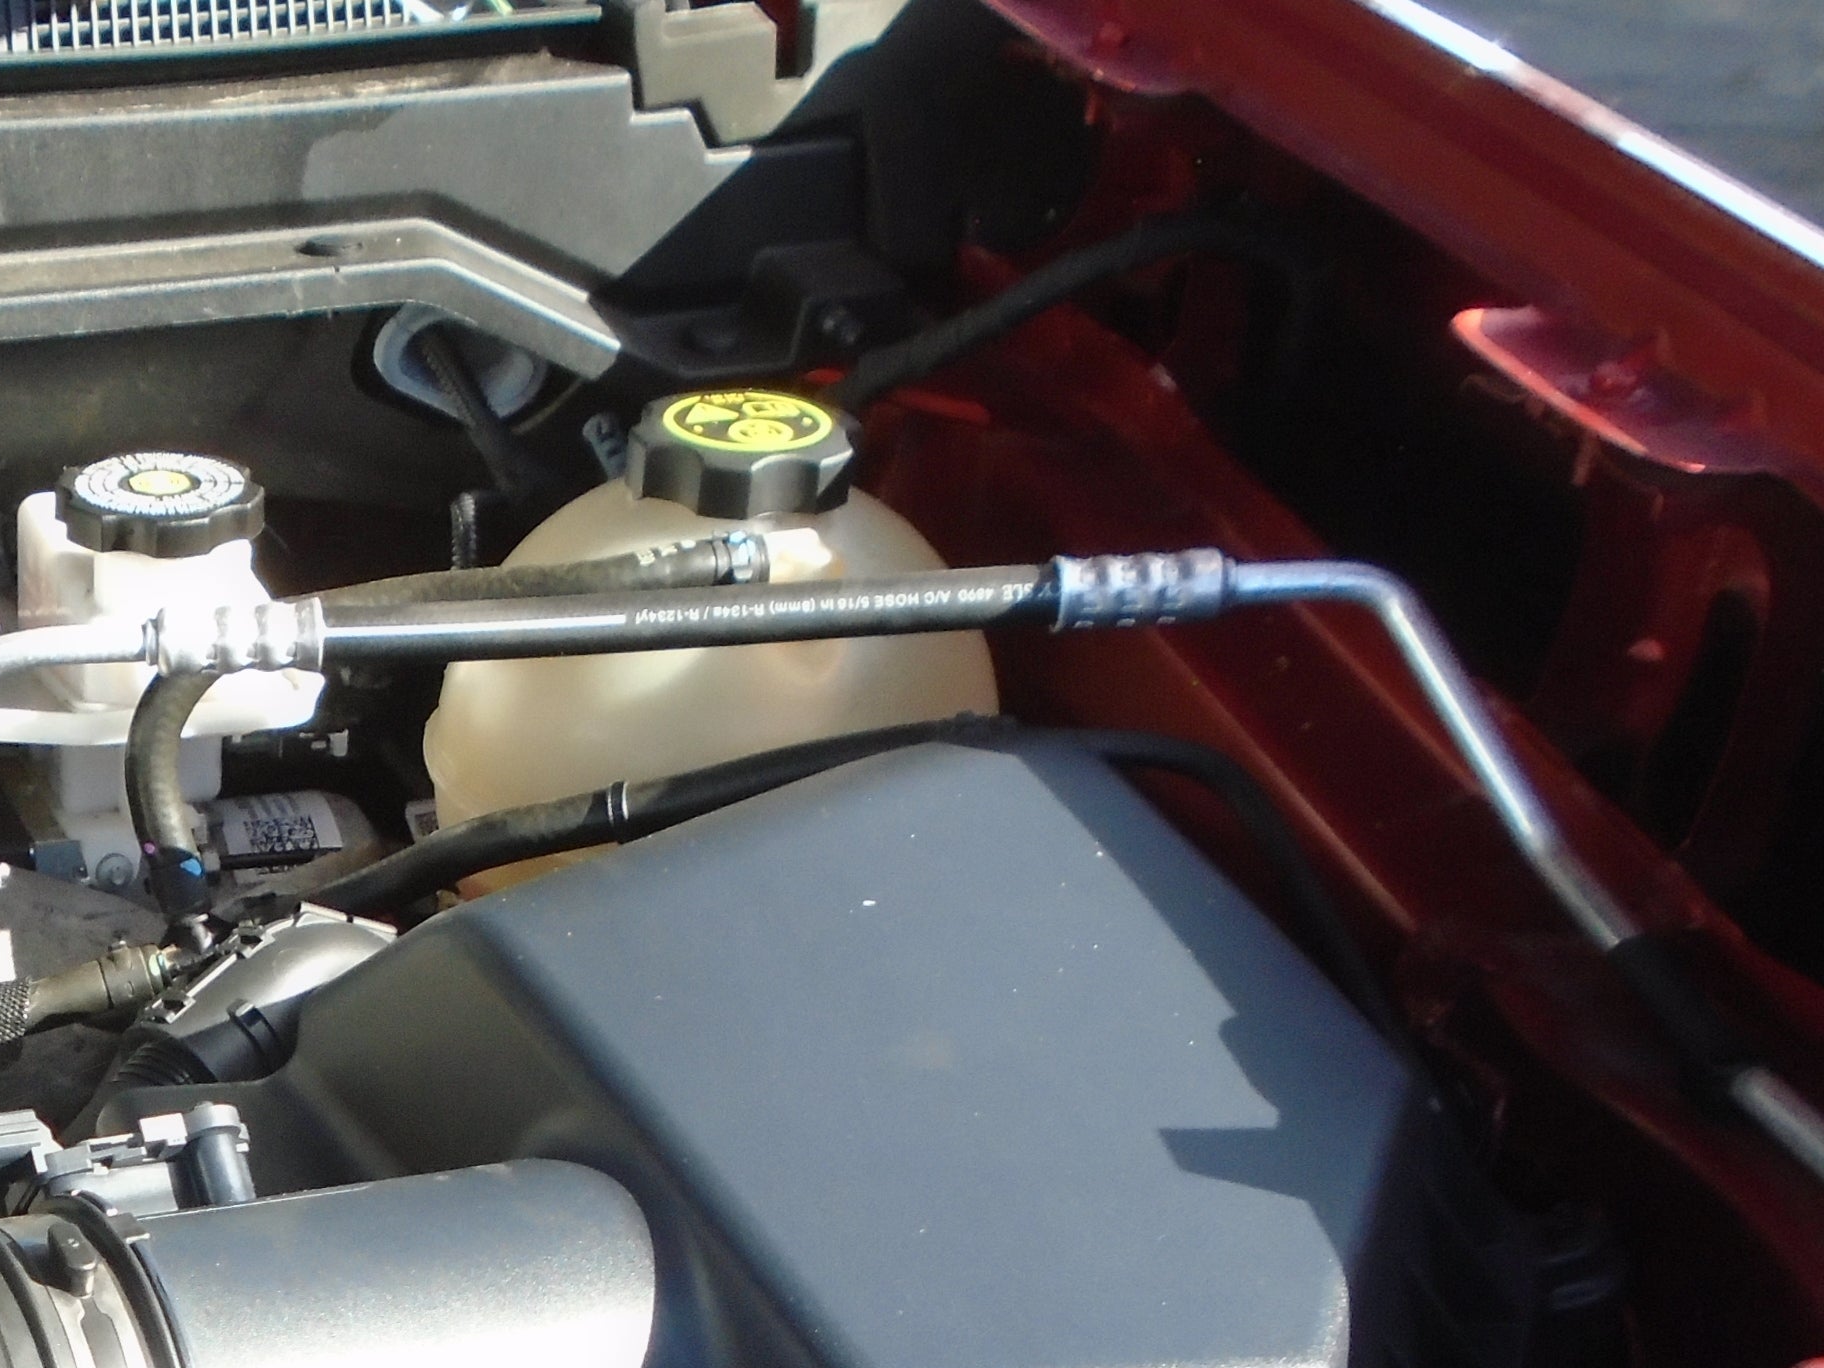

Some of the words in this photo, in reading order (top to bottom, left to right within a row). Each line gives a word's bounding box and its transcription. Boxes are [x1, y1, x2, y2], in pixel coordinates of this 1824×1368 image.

[837, 595, 870, 610] 5/16
[873, 592, 920, 608] HOSE
[925, 589, 951, 605] A/C
[712, 603, 765, 618] R-134a
[768, 597, 816, 615] (8mm)
